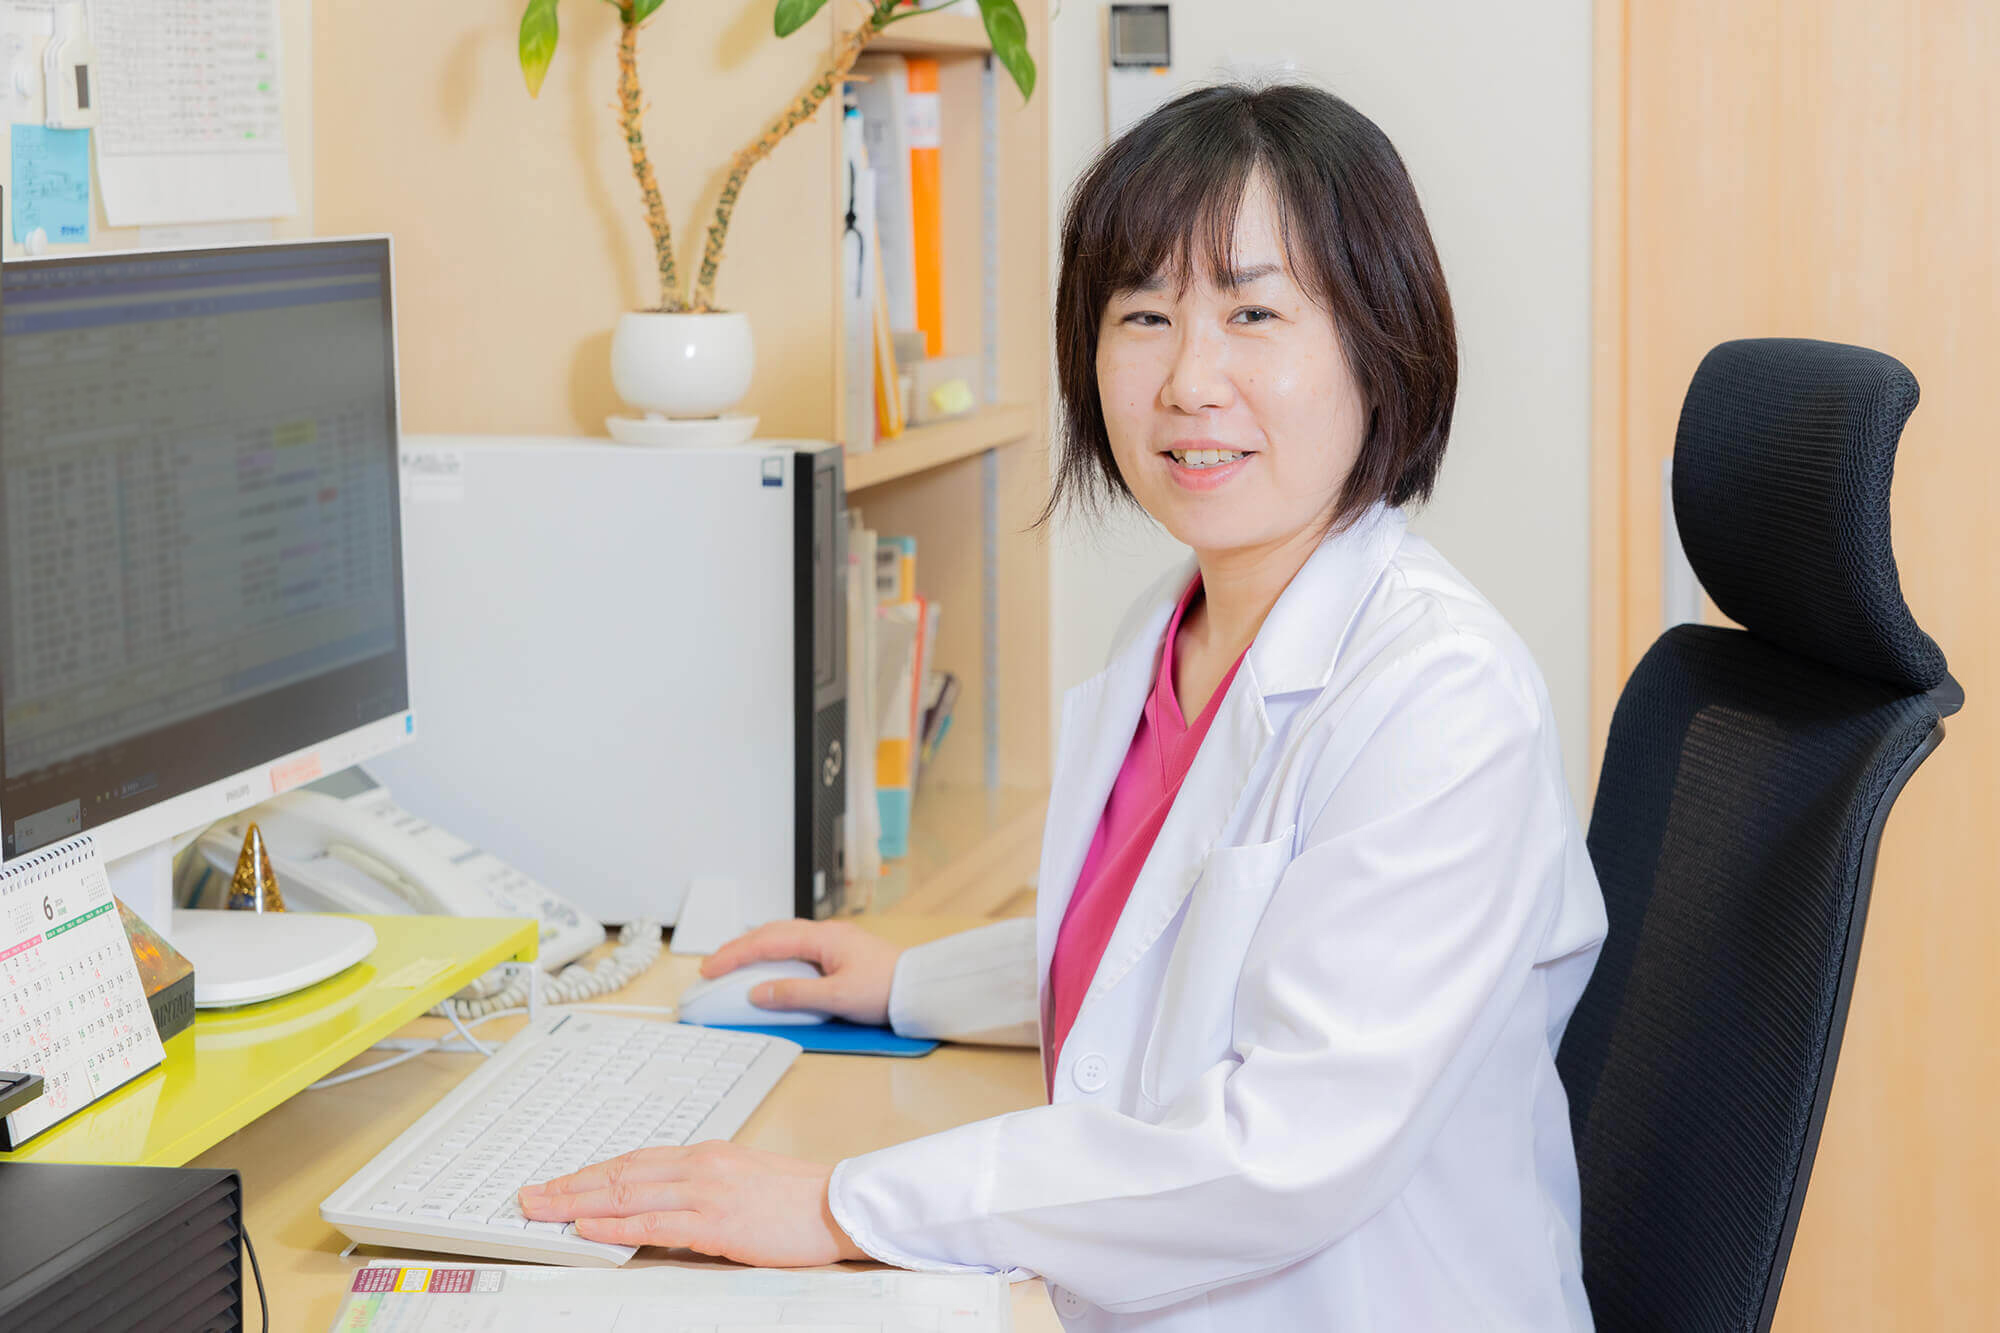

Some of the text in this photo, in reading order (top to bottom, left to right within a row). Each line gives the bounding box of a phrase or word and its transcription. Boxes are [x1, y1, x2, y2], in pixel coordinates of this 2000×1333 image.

[44, 896, 54, 920] 6
[88, 989, 96, 1000] 11
[98, 984, 106, 994] 12
[108, 980, 114, 989] 13
[118, 975, 124, 985] 14
[2, 1032, 10, 1043] 13
[13, 1028, 20, 1038] 14
[24, 1022, 32, 1032] 15
[44, 1012, 52, 1022] 17
[88, 1024, 94, 1033] 17
[107, 1013, 114, 1023] 19
[126, 1003, 133, 1014] 21
[23, 1058, 30, 1068] 21
[33, 1052, 41, 1064] 22
[54, 1042, 61, 1052] 24
[98, 1052, 106, 1063] 24
[108, 1047, 116, 1058] 25
[117, 1042, 124, 1052] 26
[126, 1037, 133, 1048] 27
[63, 1072, 70, 1082] 31
